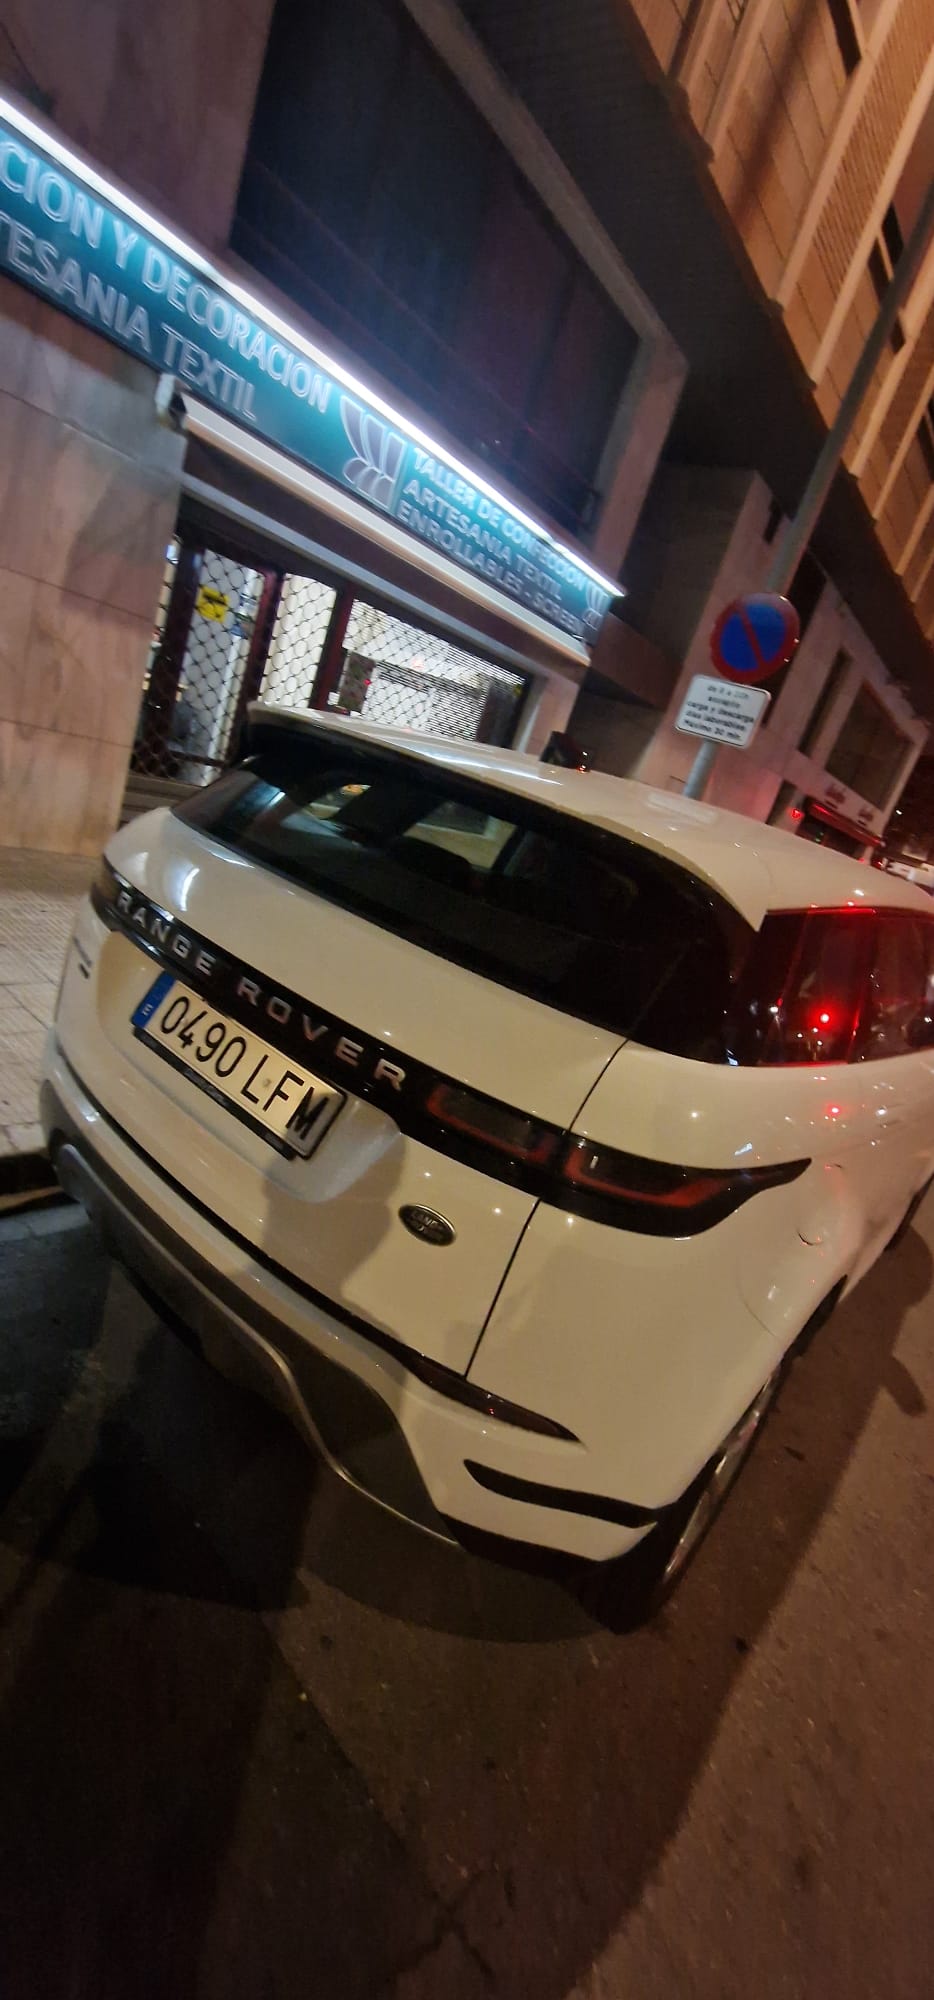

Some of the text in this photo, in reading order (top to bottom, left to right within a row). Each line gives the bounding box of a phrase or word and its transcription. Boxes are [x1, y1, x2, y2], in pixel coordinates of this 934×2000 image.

[0, 141, 332, 414] CION Y DECORACION
[161, 323, 257, 421] TEXTIL
[397, 499, 522, 594] ENROLLABLES
[403, 480, 562, 601] ARTESANIA TEXTIL
[413, 447, 585, 591] TALLER DE CONFECCION
[117, 892, 407, 1091] RANGE ROVER
[160, 996, 247, 1077] 0490
[240, 1054, 329, 1140] LFM
